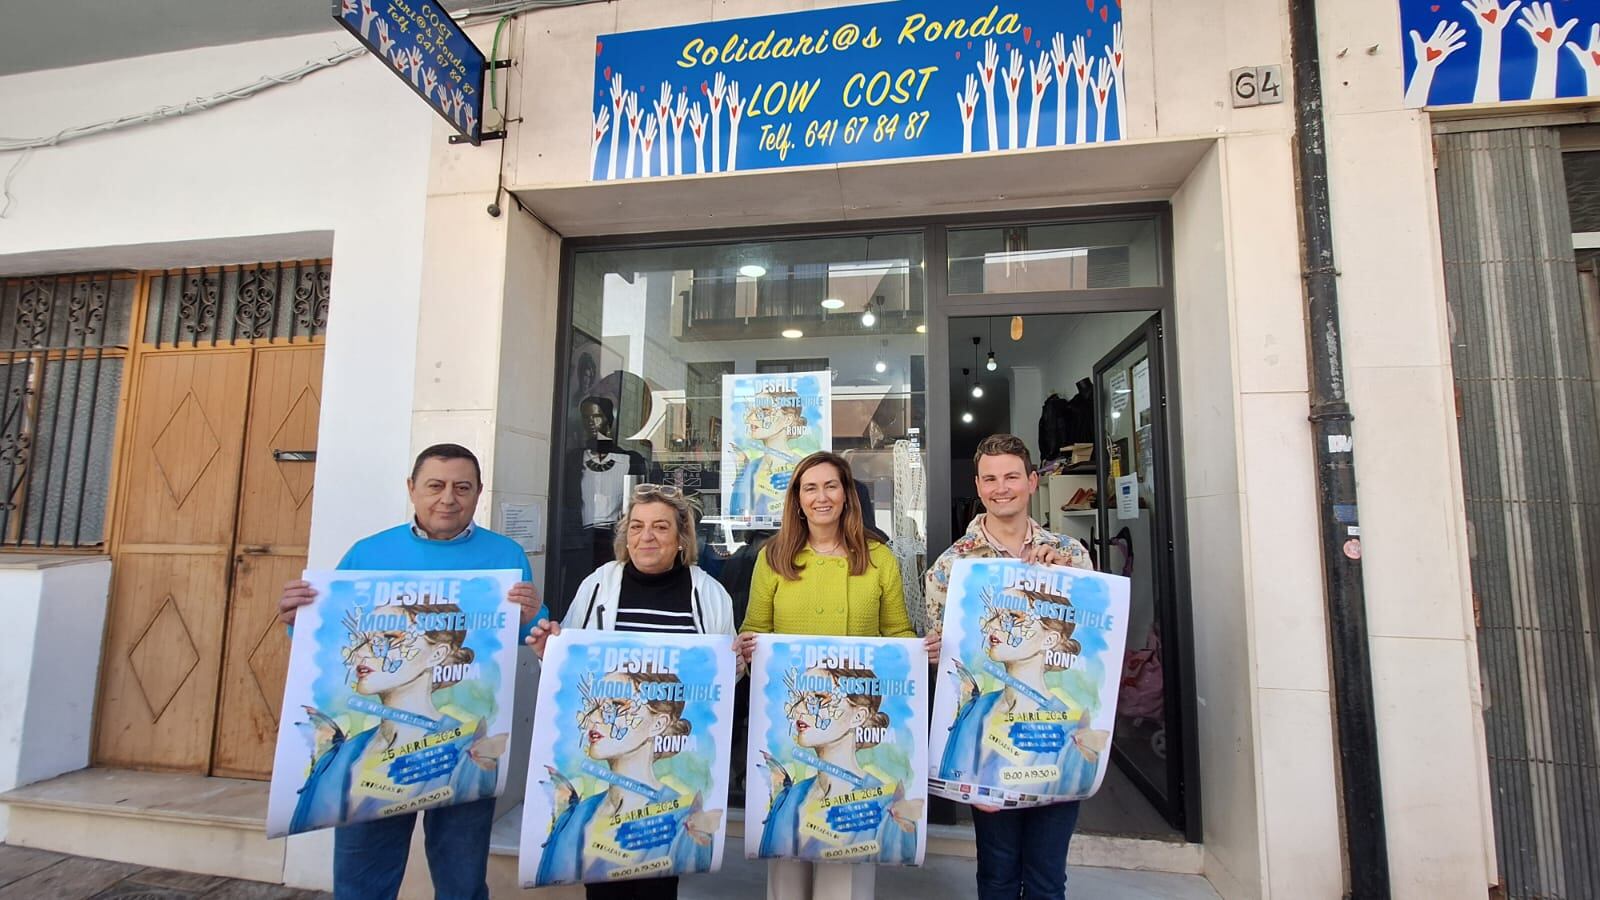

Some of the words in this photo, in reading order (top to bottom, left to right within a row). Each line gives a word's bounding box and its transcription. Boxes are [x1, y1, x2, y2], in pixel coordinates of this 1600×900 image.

[421, 4, 453, 40] COST
[387, 3, 410, 33] Telf.
[416, 33, 435, 55] 641
[436, 54, 449, 68] 67
[450, 69, 462, 83] 84
[462, 83, 475, 95] 87
[676, 23, 882, 68] Solidari@s
[897, 5, 1021, 45] Ronda
[435, 36, 467, 75] Ronda
[747, 78, 821, 117] LOW
[843, 66, 939, 108] COST
[1236, 72, 1280, 98] 64
[759, 122, 795, 161] Telf.
[804, 119, 838, 148] 641
[843, 116, 869, 144] 67
[873, 113, 899, 143] 84
[904, 111, 930, 140] 87
[374, 580, 461, 606] DESFILE
[1003, 566, 1073, 599] DESFILE
[358, 612, 408, 632] MODA
[416, 612, 507, 632] SOSTENIBLE
[992, 592, 1028, 612] MODA
[1034, 600, 1114, 631] SOSTENIBLE
[604, 647, 680, 674] DESFILE
[805, 645, 875, 670] DESFILE
[433, 663, 481, 682] RONDA
[795, 674, 833, 694] MODA
[840, 676, 915, 697] SOSTENIBLE
[590, 680, 633, 699] MODA
[640, 682, 721, 702] SOSTENIBLE
[1004, 713, 1014, 722] 25
[1017, 712, 1042, 721] ABRIL
[1046, 711, 1068, 721] 2026
[381, 749, 396, 762] 25
[400, 738, 429, 755] ABRIL
[435, 728, 461, 745] 2026
[820, 798, 831, 809] 25
[834, 792, 858, 805] ABRIL
[862, 787, 883, 799] 2026
[609, 814, 622, 826] 25
[625, 807, 651, 821] ABRIL
[655, 799, 680, 814] 2026
